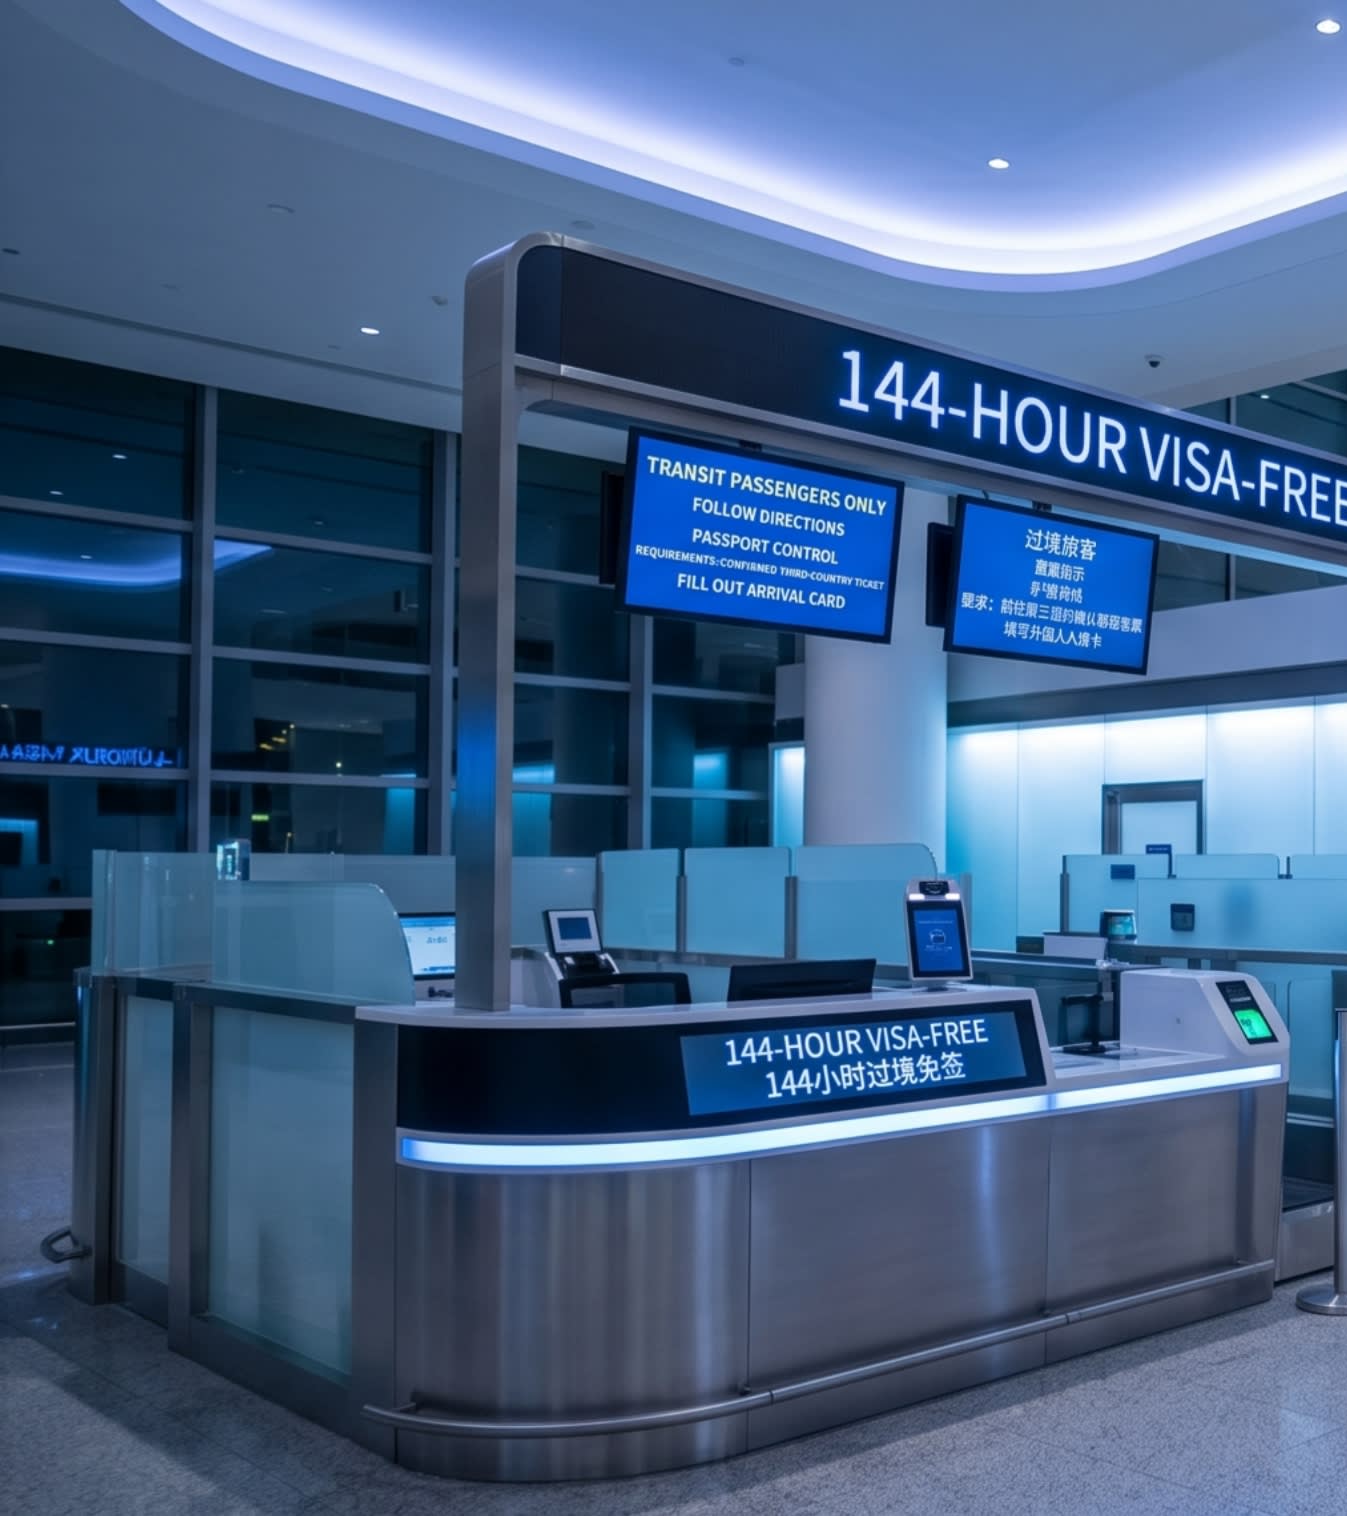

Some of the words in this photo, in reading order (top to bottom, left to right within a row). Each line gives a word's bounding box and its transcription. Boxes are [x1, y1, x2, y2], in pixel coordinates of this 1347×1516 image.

[838, 350, 1127, 474] 144-HOUR
[648, 456, 727, 486] TRANSIT
[731, 472, 841, 508] PASSENGERS
[844, 495, 887, 516] ONLY
[692, 497, 757, 522] FOLLOW
[760, 509, 845, 537] DIRECTIONS
[692, 529, 770, 554] PASSPORT
[773, 541, 839, 565] CONTROL
[677, 573, 709, 592] FILL
[713, 579, 745, 597] OUT
[747, 584, 806, 605] ARRIVAL
[809, 592, 846, 609] CARD
[725, 1029, 864, 1065] 144-HOUR
[866, 1018, 989, 1052] VISA-FREE
[766, 1051, 966, 1098] 144小时过境免签
